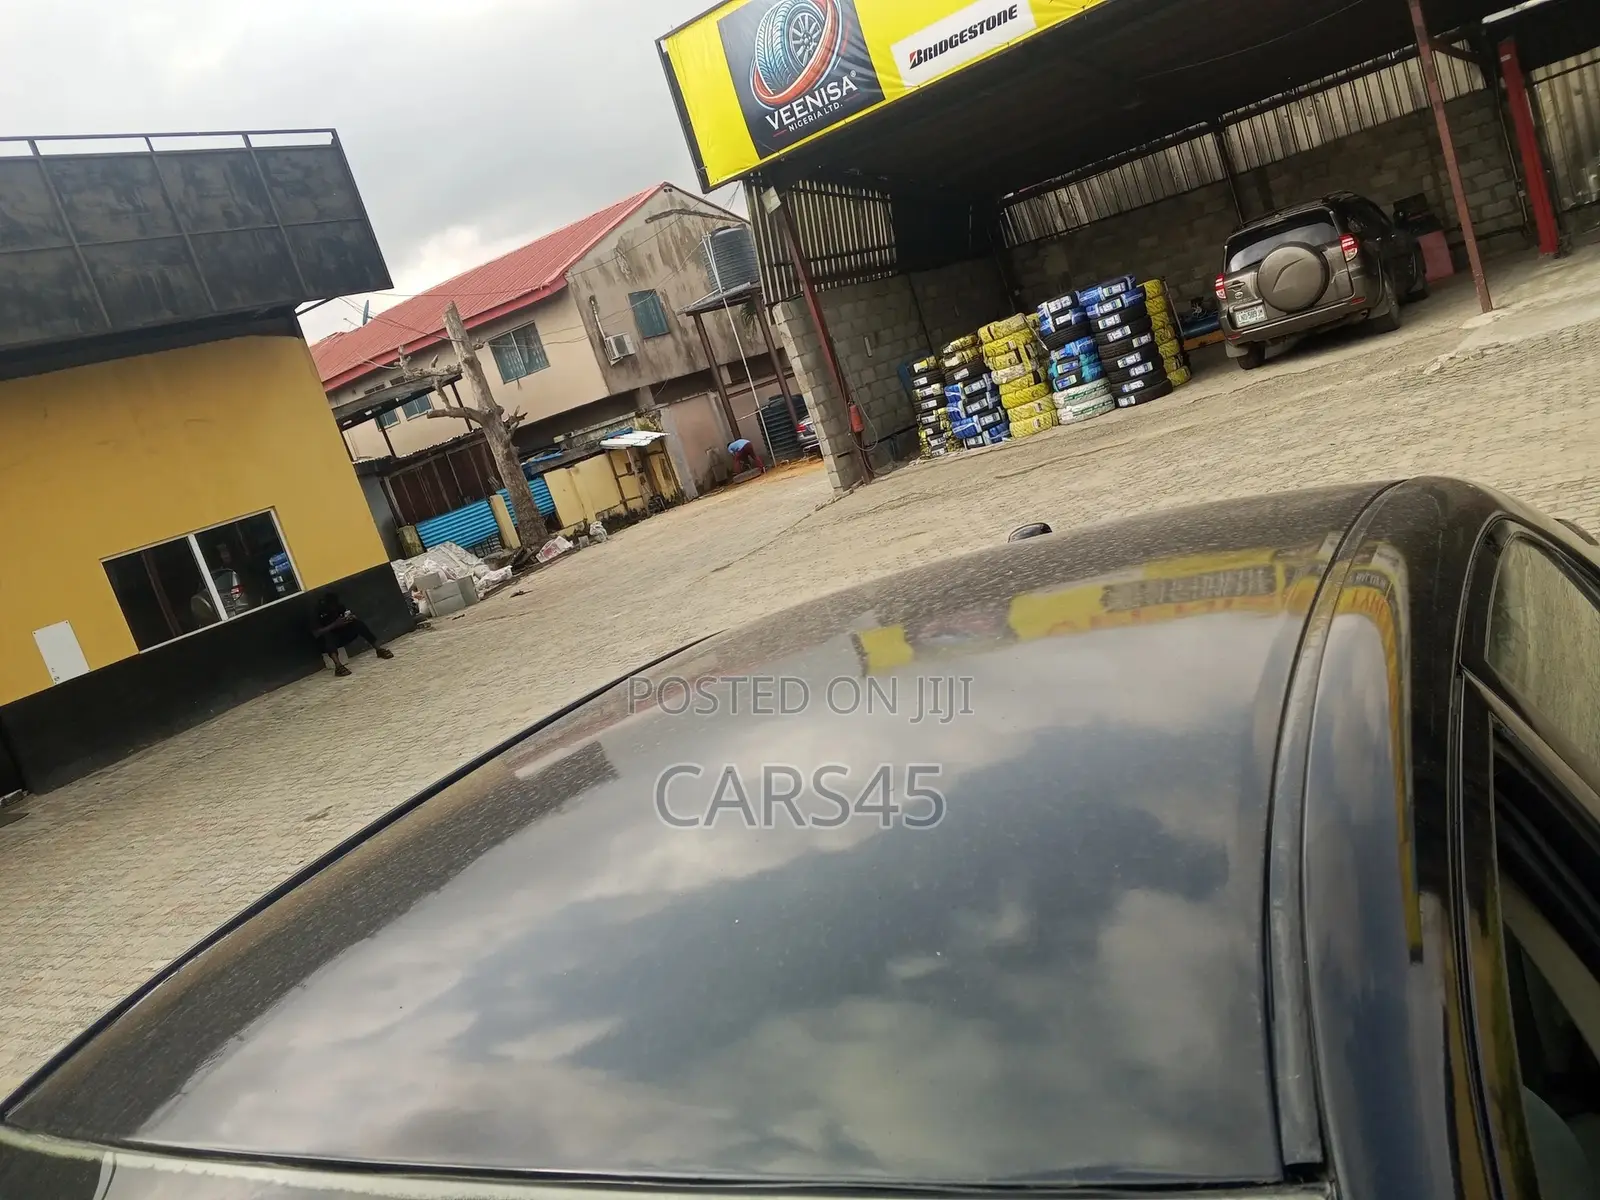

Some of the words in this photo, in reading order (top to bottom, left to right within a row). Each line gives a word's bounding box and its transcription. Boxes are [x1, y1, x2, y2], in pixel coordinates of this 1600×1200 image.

[909, 4, 1018, 70] BRIDGESTONE
[764, 75, 858, 131] VEENISA
[788, 112, 823, 132] NIGERIA
[824, 102, 843, 114] LTD.
